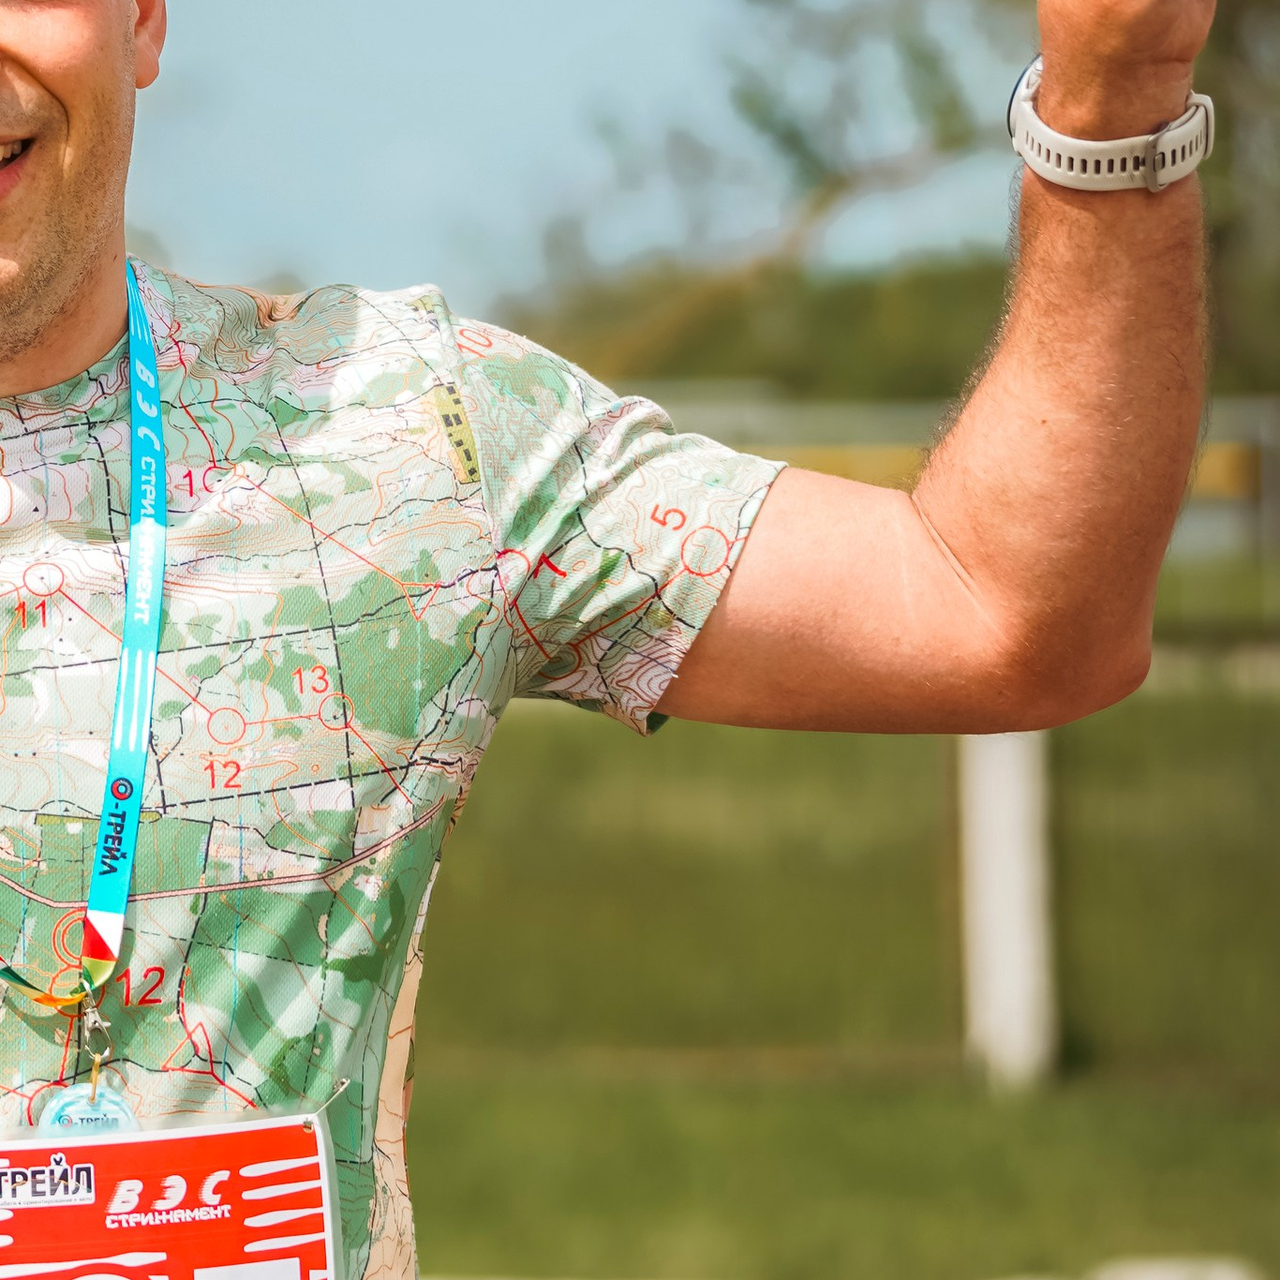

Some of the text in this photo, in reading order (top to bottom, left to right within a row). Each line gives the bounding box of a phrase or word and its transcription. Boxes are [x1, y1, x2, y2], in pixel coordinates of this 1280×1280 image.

[650, 504, 686, 532] 5
[15, 600, 47, 629] 11
[292, 665, 329, 694] 13
[204, 761, 242, 789] 12
[116, 966, 165, 1006] 12
[105, 1204, 231, 1229] СТРИЖАМЕНТ
